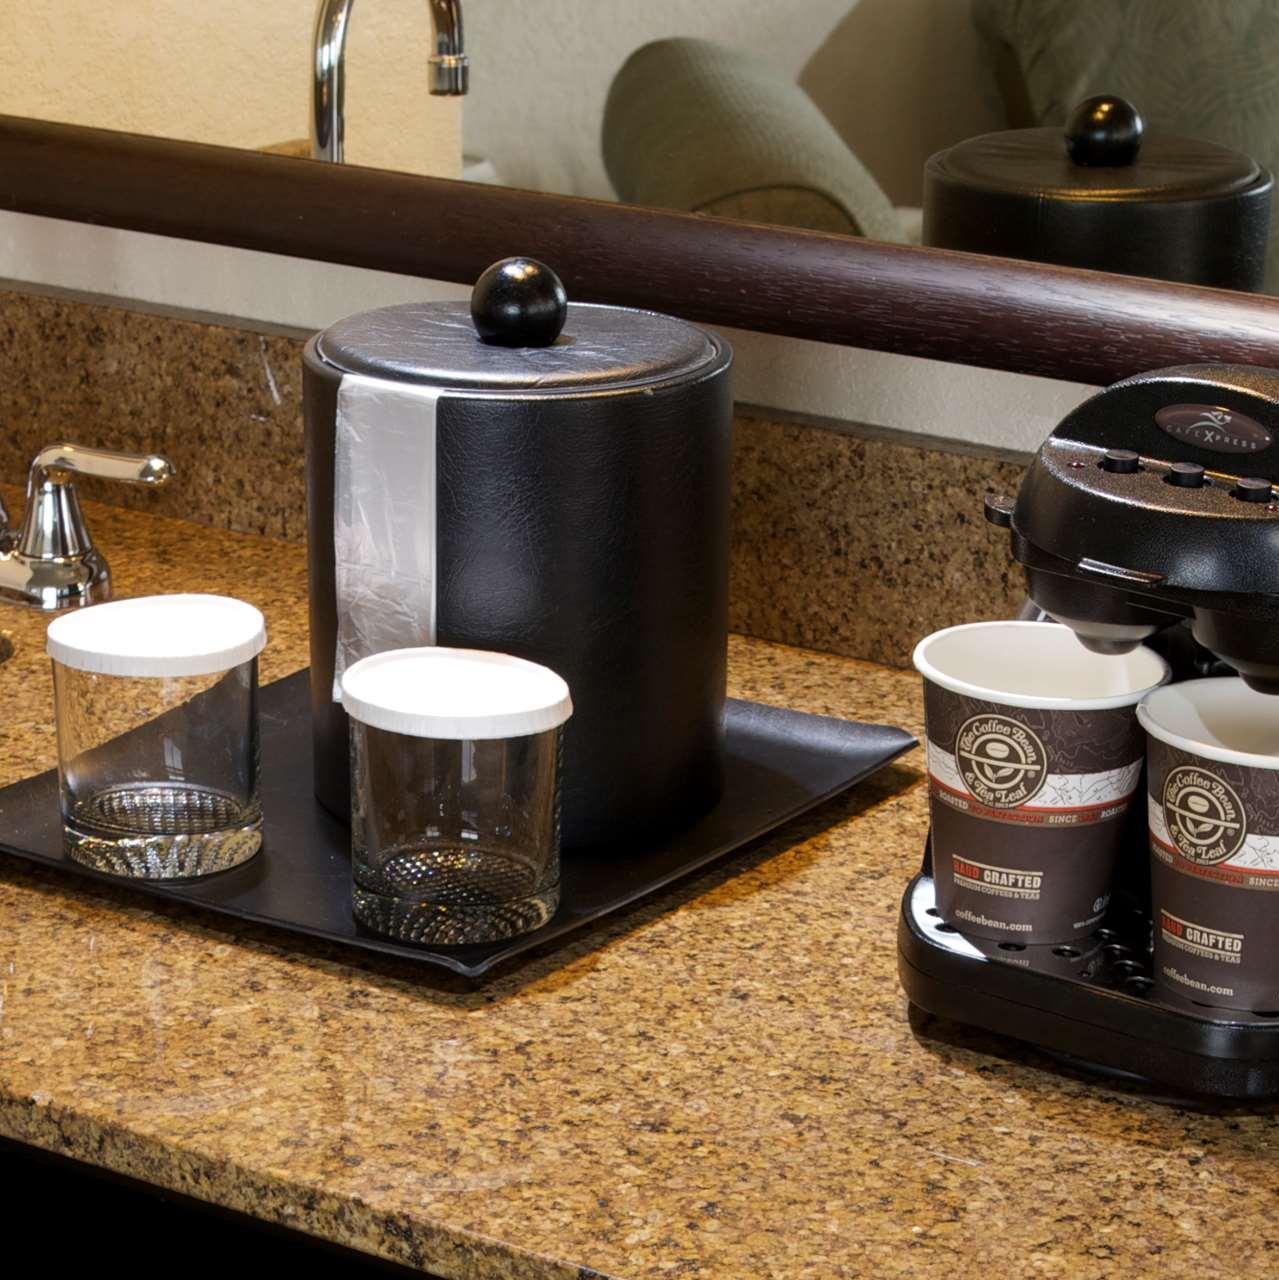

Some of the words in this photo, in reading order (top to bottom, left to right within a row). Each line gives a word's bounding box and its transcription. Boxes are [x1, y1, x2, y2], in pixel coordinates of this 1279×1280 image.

[960, 731, 975, 752] The
[972, 719, 1011, 735] Coffee
[1011, 726, 1038, 764] Bean
[965, 772, 975, 785] &
[974, 780, 995, 801] Tea
[995, 782, 1028, 803] Leaf
[1176, 772, 1211, 789] Coffee
[1212, 781, 1237, 820] Bean
[1049, 815, 1077, 824] SINCE
[1178, 834, 1194, 856] Tea
[1196, 840, 1226, 860] Leaf
[984, 870, 1041, 888] CRAFTED
[1020, 891, 1041, 900] TEAS
[955, 909, 1033, 932] coffeebean.com
[1186, 930, 1242, 951] CRAFTED
[1163, 966, 1234, 996] coffeebean.com
